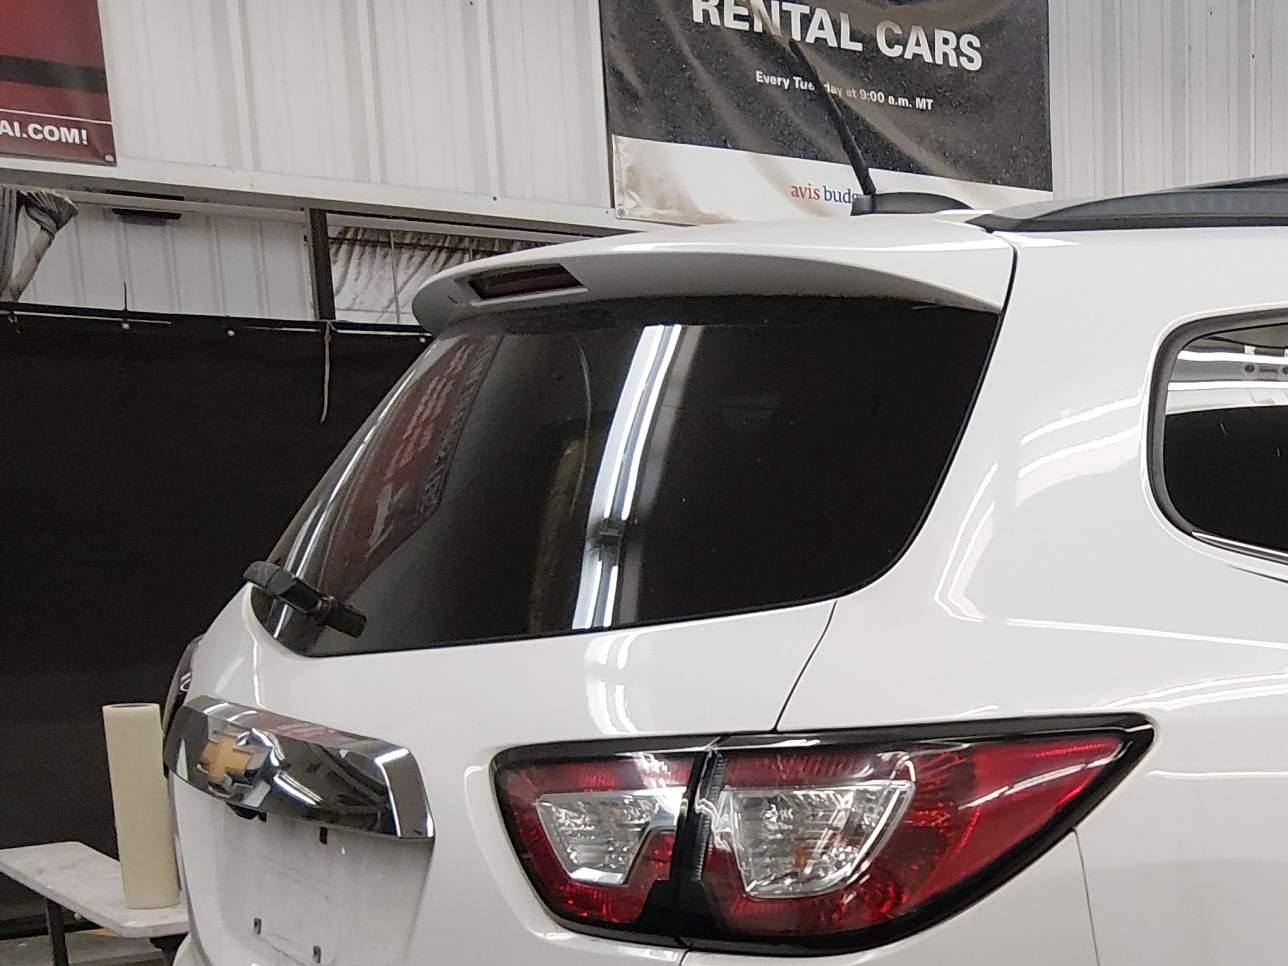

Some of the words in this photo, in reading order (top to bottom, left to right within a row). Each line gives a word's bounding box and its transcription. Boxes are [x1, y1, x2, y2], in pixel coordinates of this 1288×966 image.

[692, 0, 863, 52] RENTAL
[876, 20, 983, 72] CARS
[755, 70, 790, 90] Every
[792, 76, 842, 98] Tueday
[846, 88, 858, 99] at
[859, 89, 886, 104] 9:00
[888, 95, 912, 108] a.m.
[915, 97, 934, 111] MT
[791, 183, 820, 200] avis
